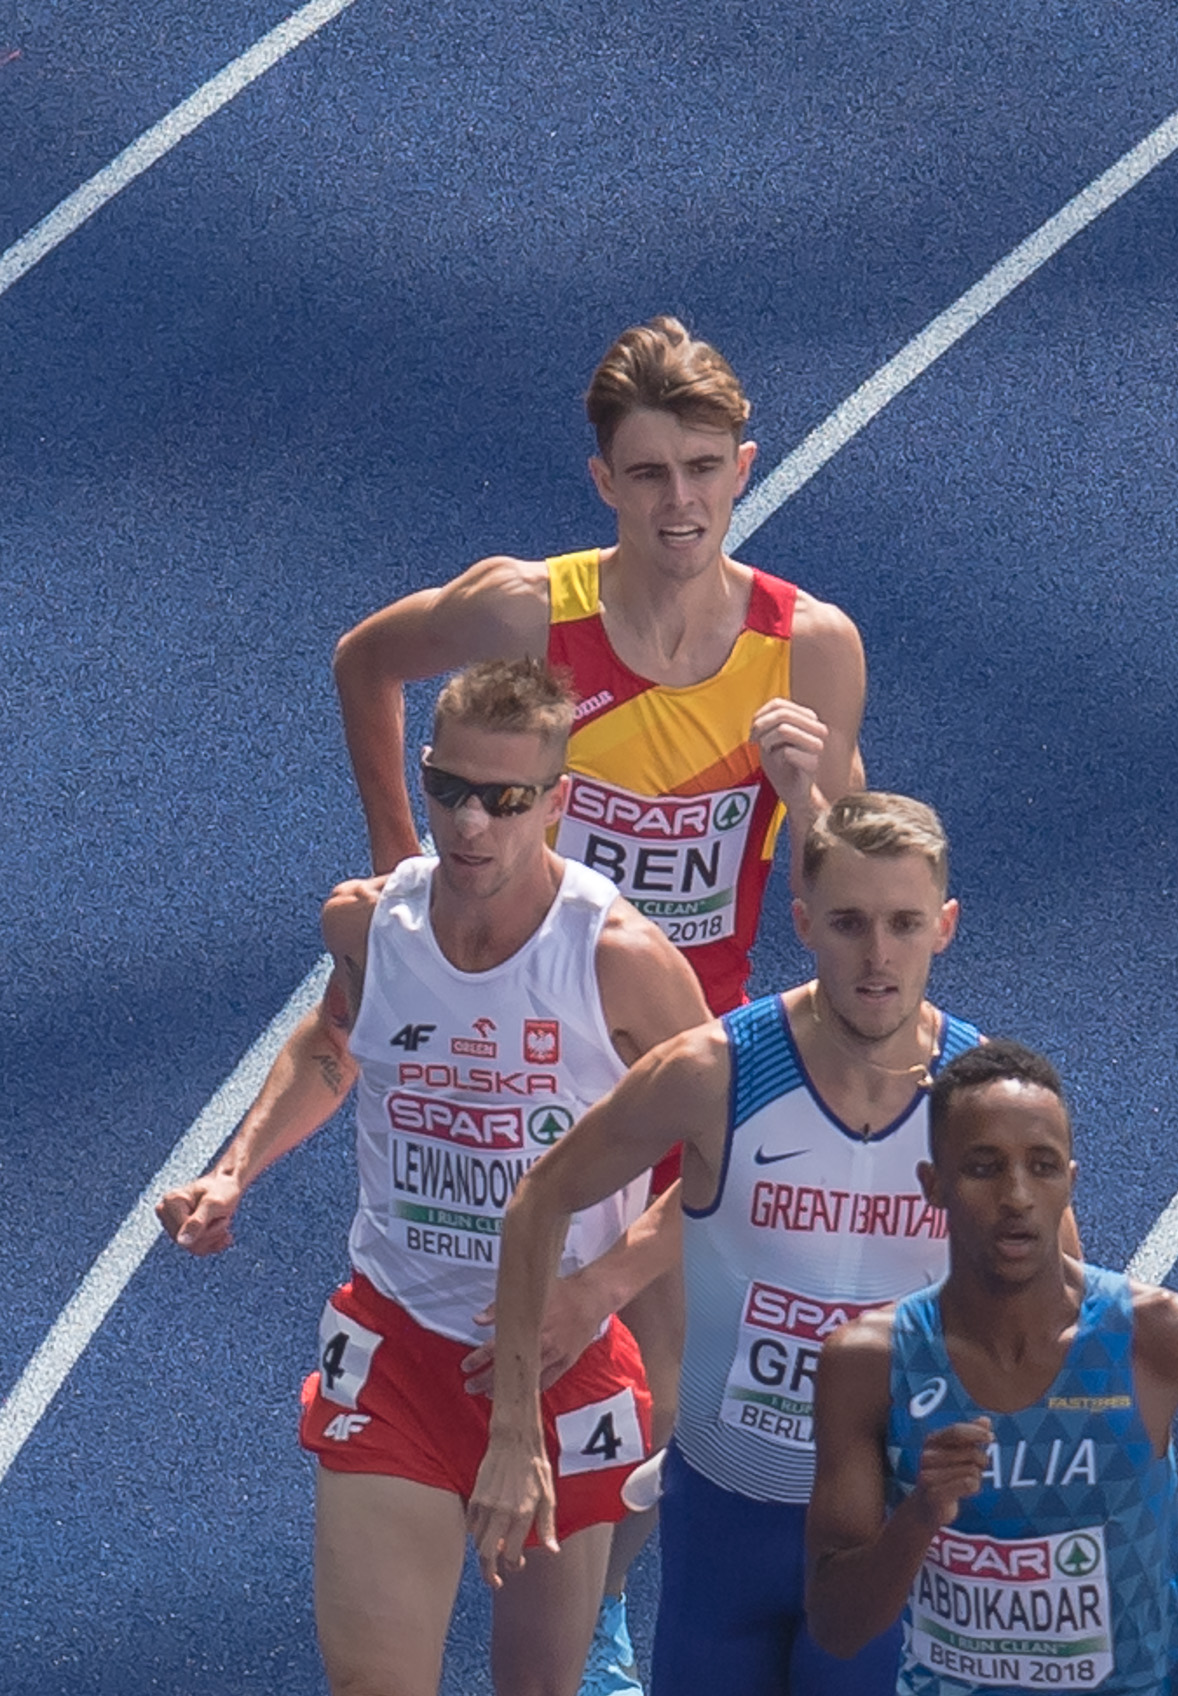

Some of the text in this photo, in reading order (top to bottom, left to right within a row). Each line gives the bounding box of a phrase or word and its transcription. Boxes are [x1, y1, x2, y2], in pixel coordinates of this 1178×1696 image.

[573, 690, 614, 720] oma
[571, 786, 709, 835] SPAR
[585, 834, 721, 893] BEN
[668, 915, 722, 941] 2018
[390, 1024, 437, 1051] 4F
[400, 1063, 557, 1095] POLSKA
[393, 1096, 521, 1144] SPAR
[393, 1138, 533, 1208] LEWANDOW
[438, 1210, 473, 1229] RUN
[476, 1217, 502, 1232] CLE
[750, 1181, 950, 1239] GREAT BRITAI
[407, 1226, 494, 1262] BERLIN
[751, 1290, 849, 1337] SPA
[322, 1331, 350, 1390] 4
[749, 1337, 820, 1392] GR
[323, 1413, 373, 1441] 4F
[580, 1412, 622, 1460] 4
[741, 1404, 813, 1442] BERL
[981, 1438, 1097, 1489] ALIA
[919, 1565, 1103, 1633] ABDIKADAR
[930, 1641, 1095, 1682] BERLIN 2018
[958, 1637, 995, 1652] RUN
